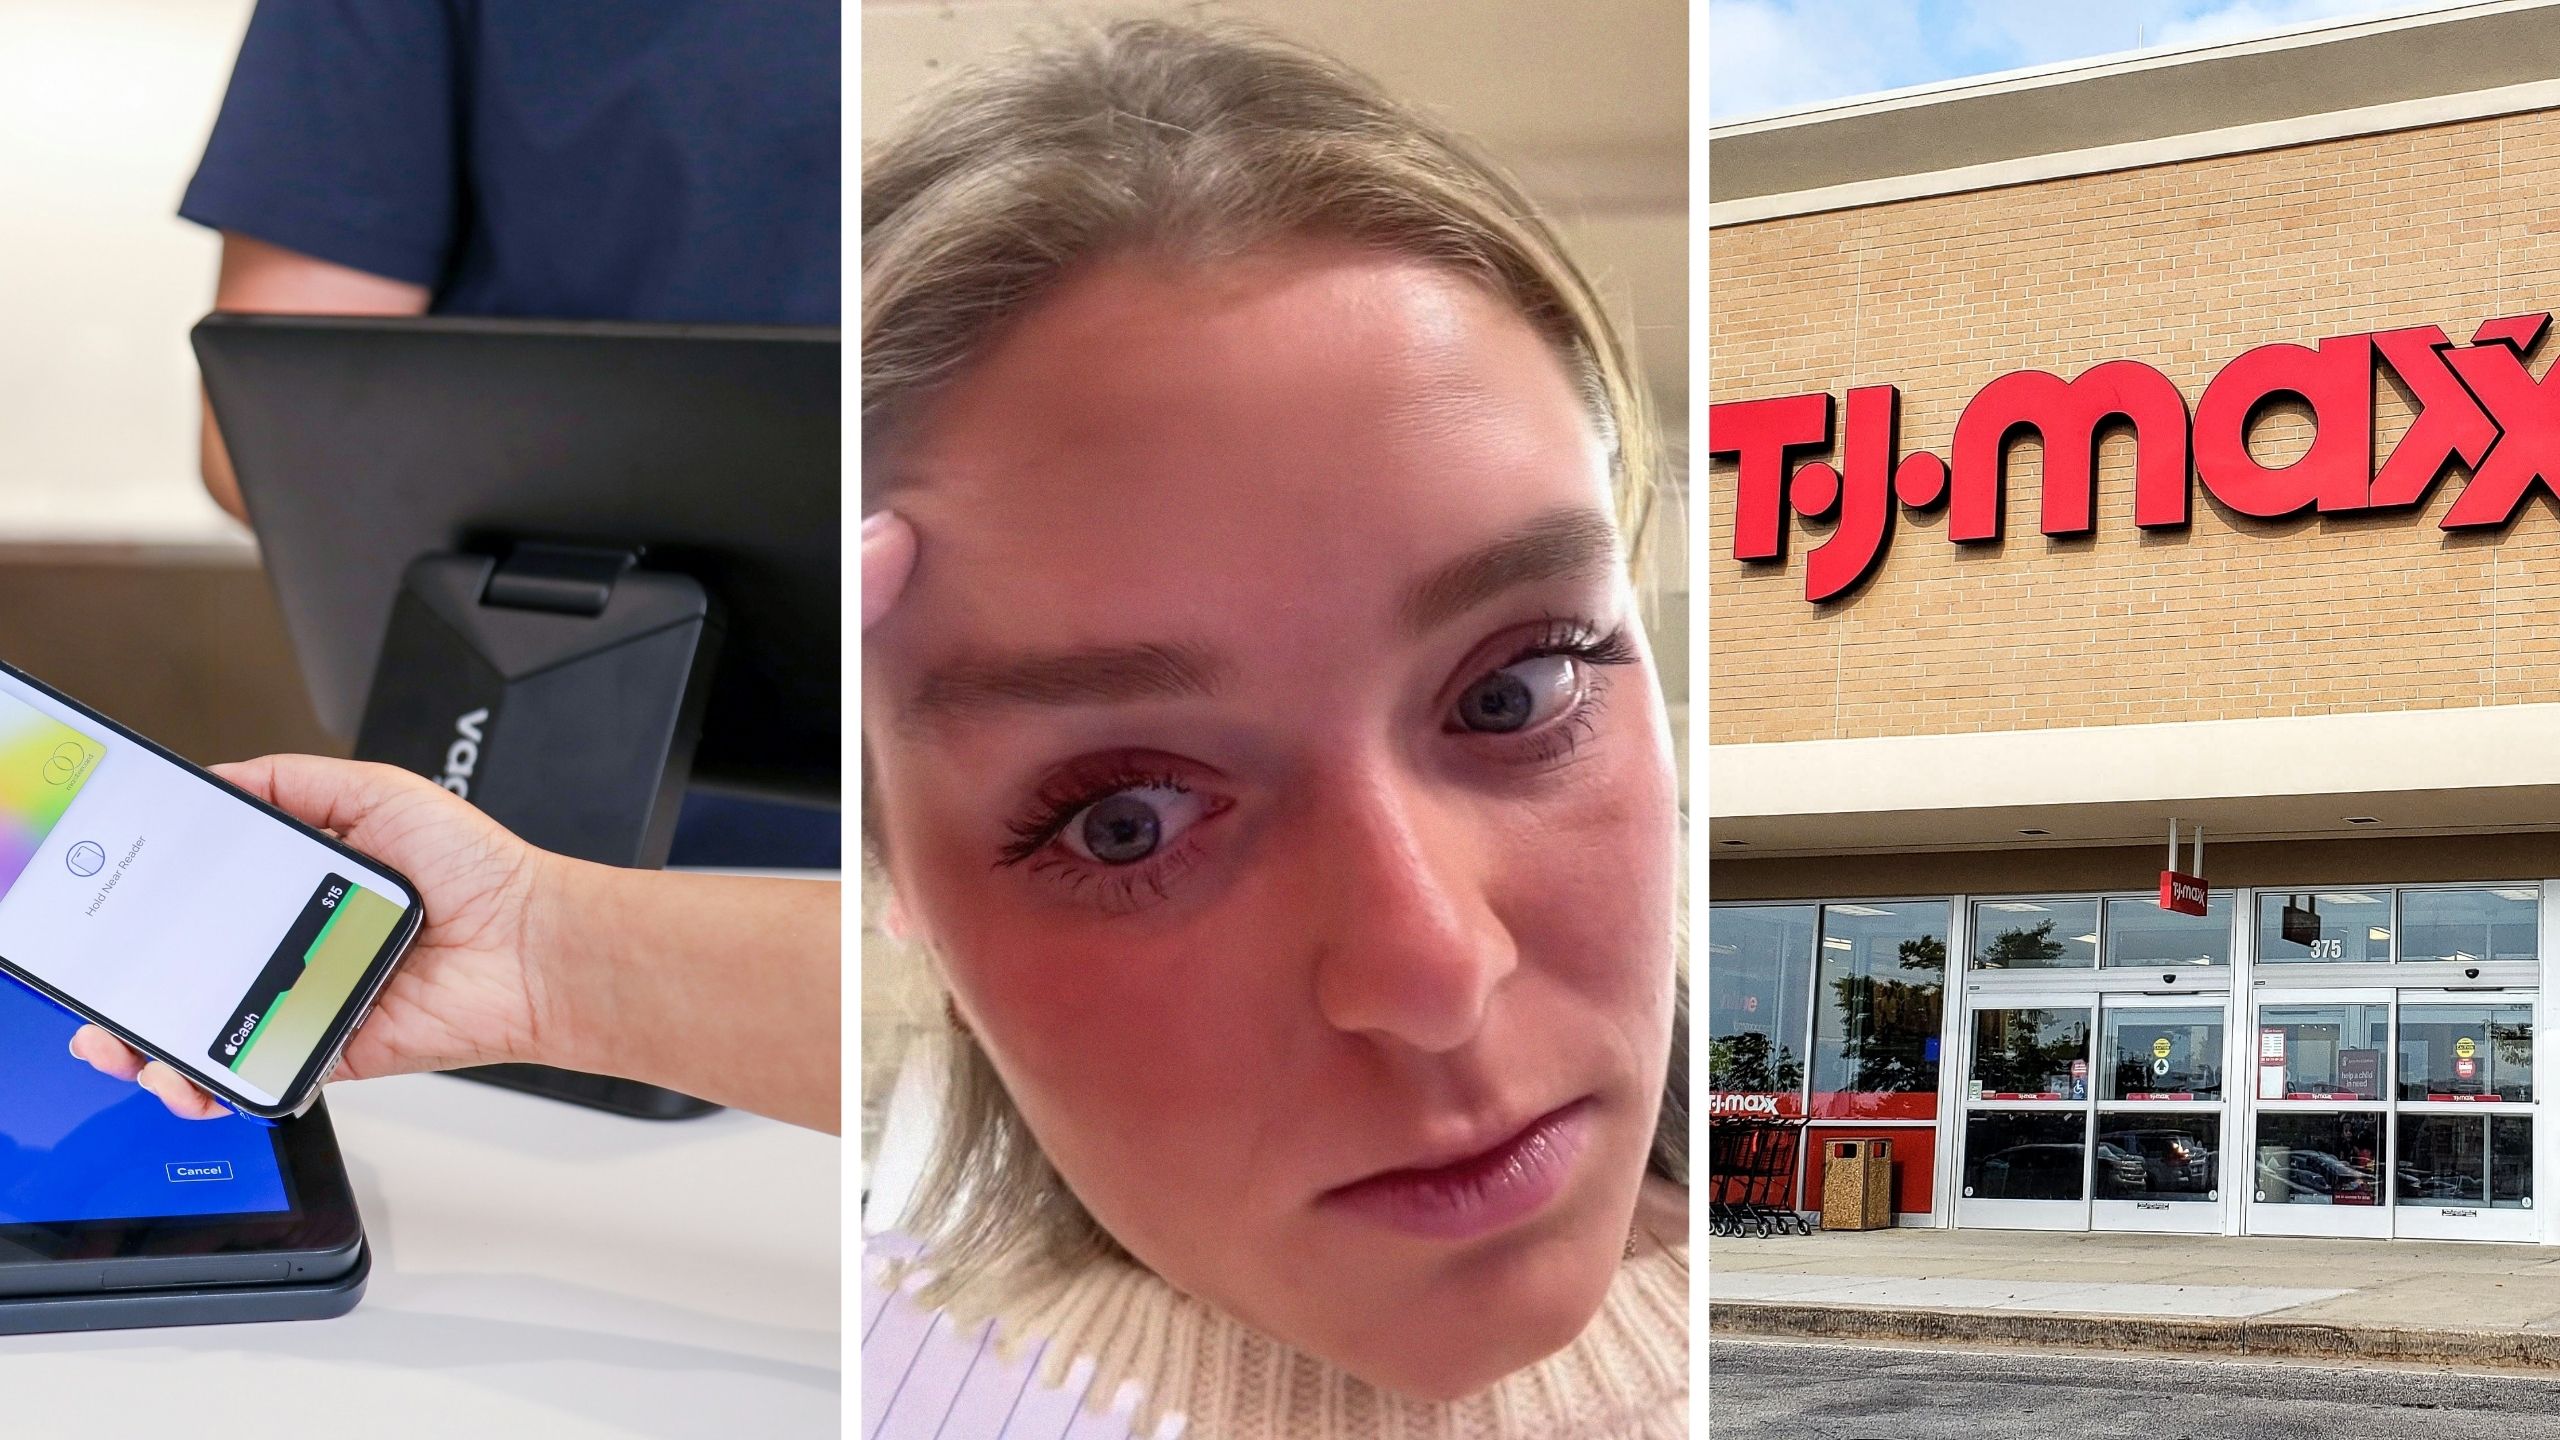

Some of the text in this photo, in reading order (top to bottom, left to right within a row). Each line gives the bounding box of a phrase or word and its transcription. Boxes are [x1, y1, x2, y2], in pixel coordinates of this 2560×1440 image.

[85, 835, 147, 918] Hold Near Reader
[321, 885, 343, 909] $15
[2310, 939, 2342, 958] 375
[230, 1012, 260, 1046] Cash
[176, 1165, 222, 1176] Cancel
